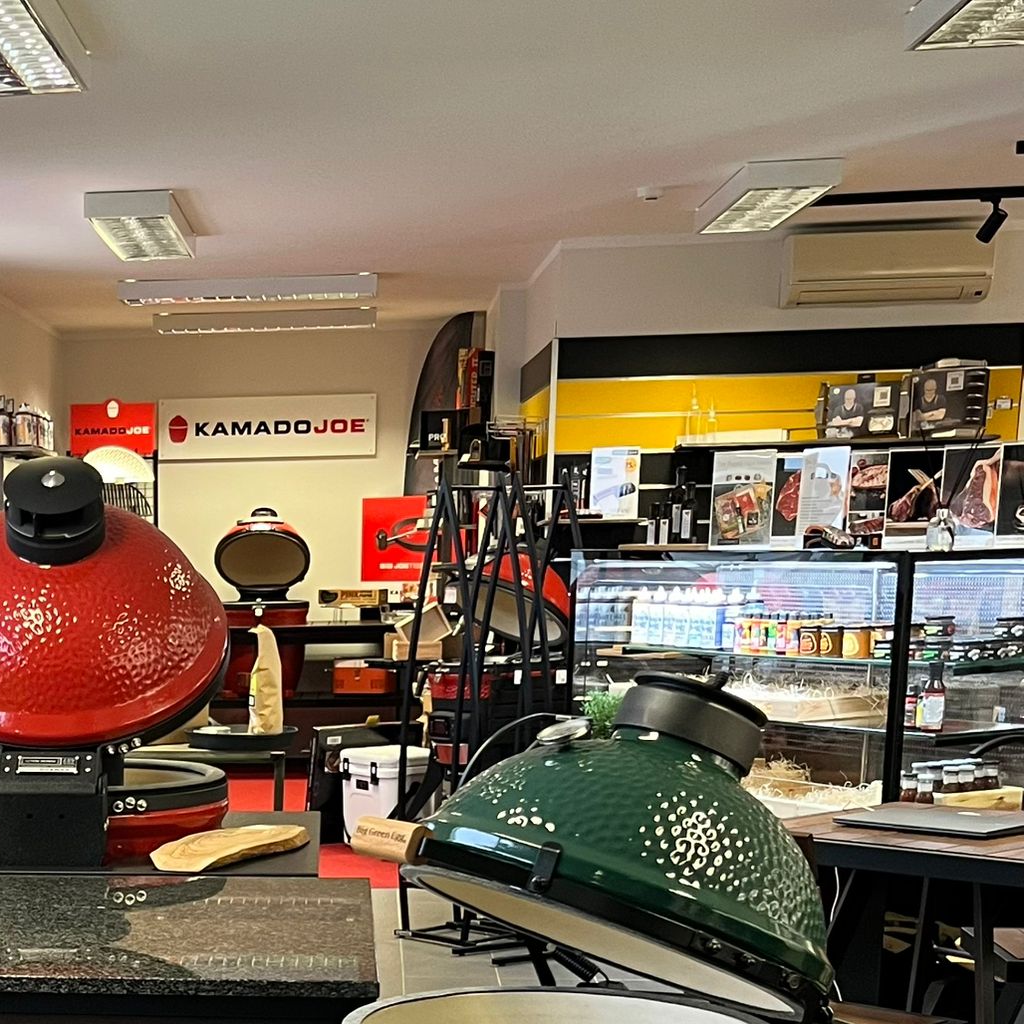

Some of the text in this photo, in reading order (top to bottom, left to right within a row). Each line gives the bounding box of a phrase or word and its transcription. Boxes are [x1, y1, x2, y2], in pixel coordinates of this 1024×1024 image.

[75, 426, 151, 436] KAMADOJOE
[195, 418, 366, 437] KAMADOJOE
[368, 827, 391, 840] Green
